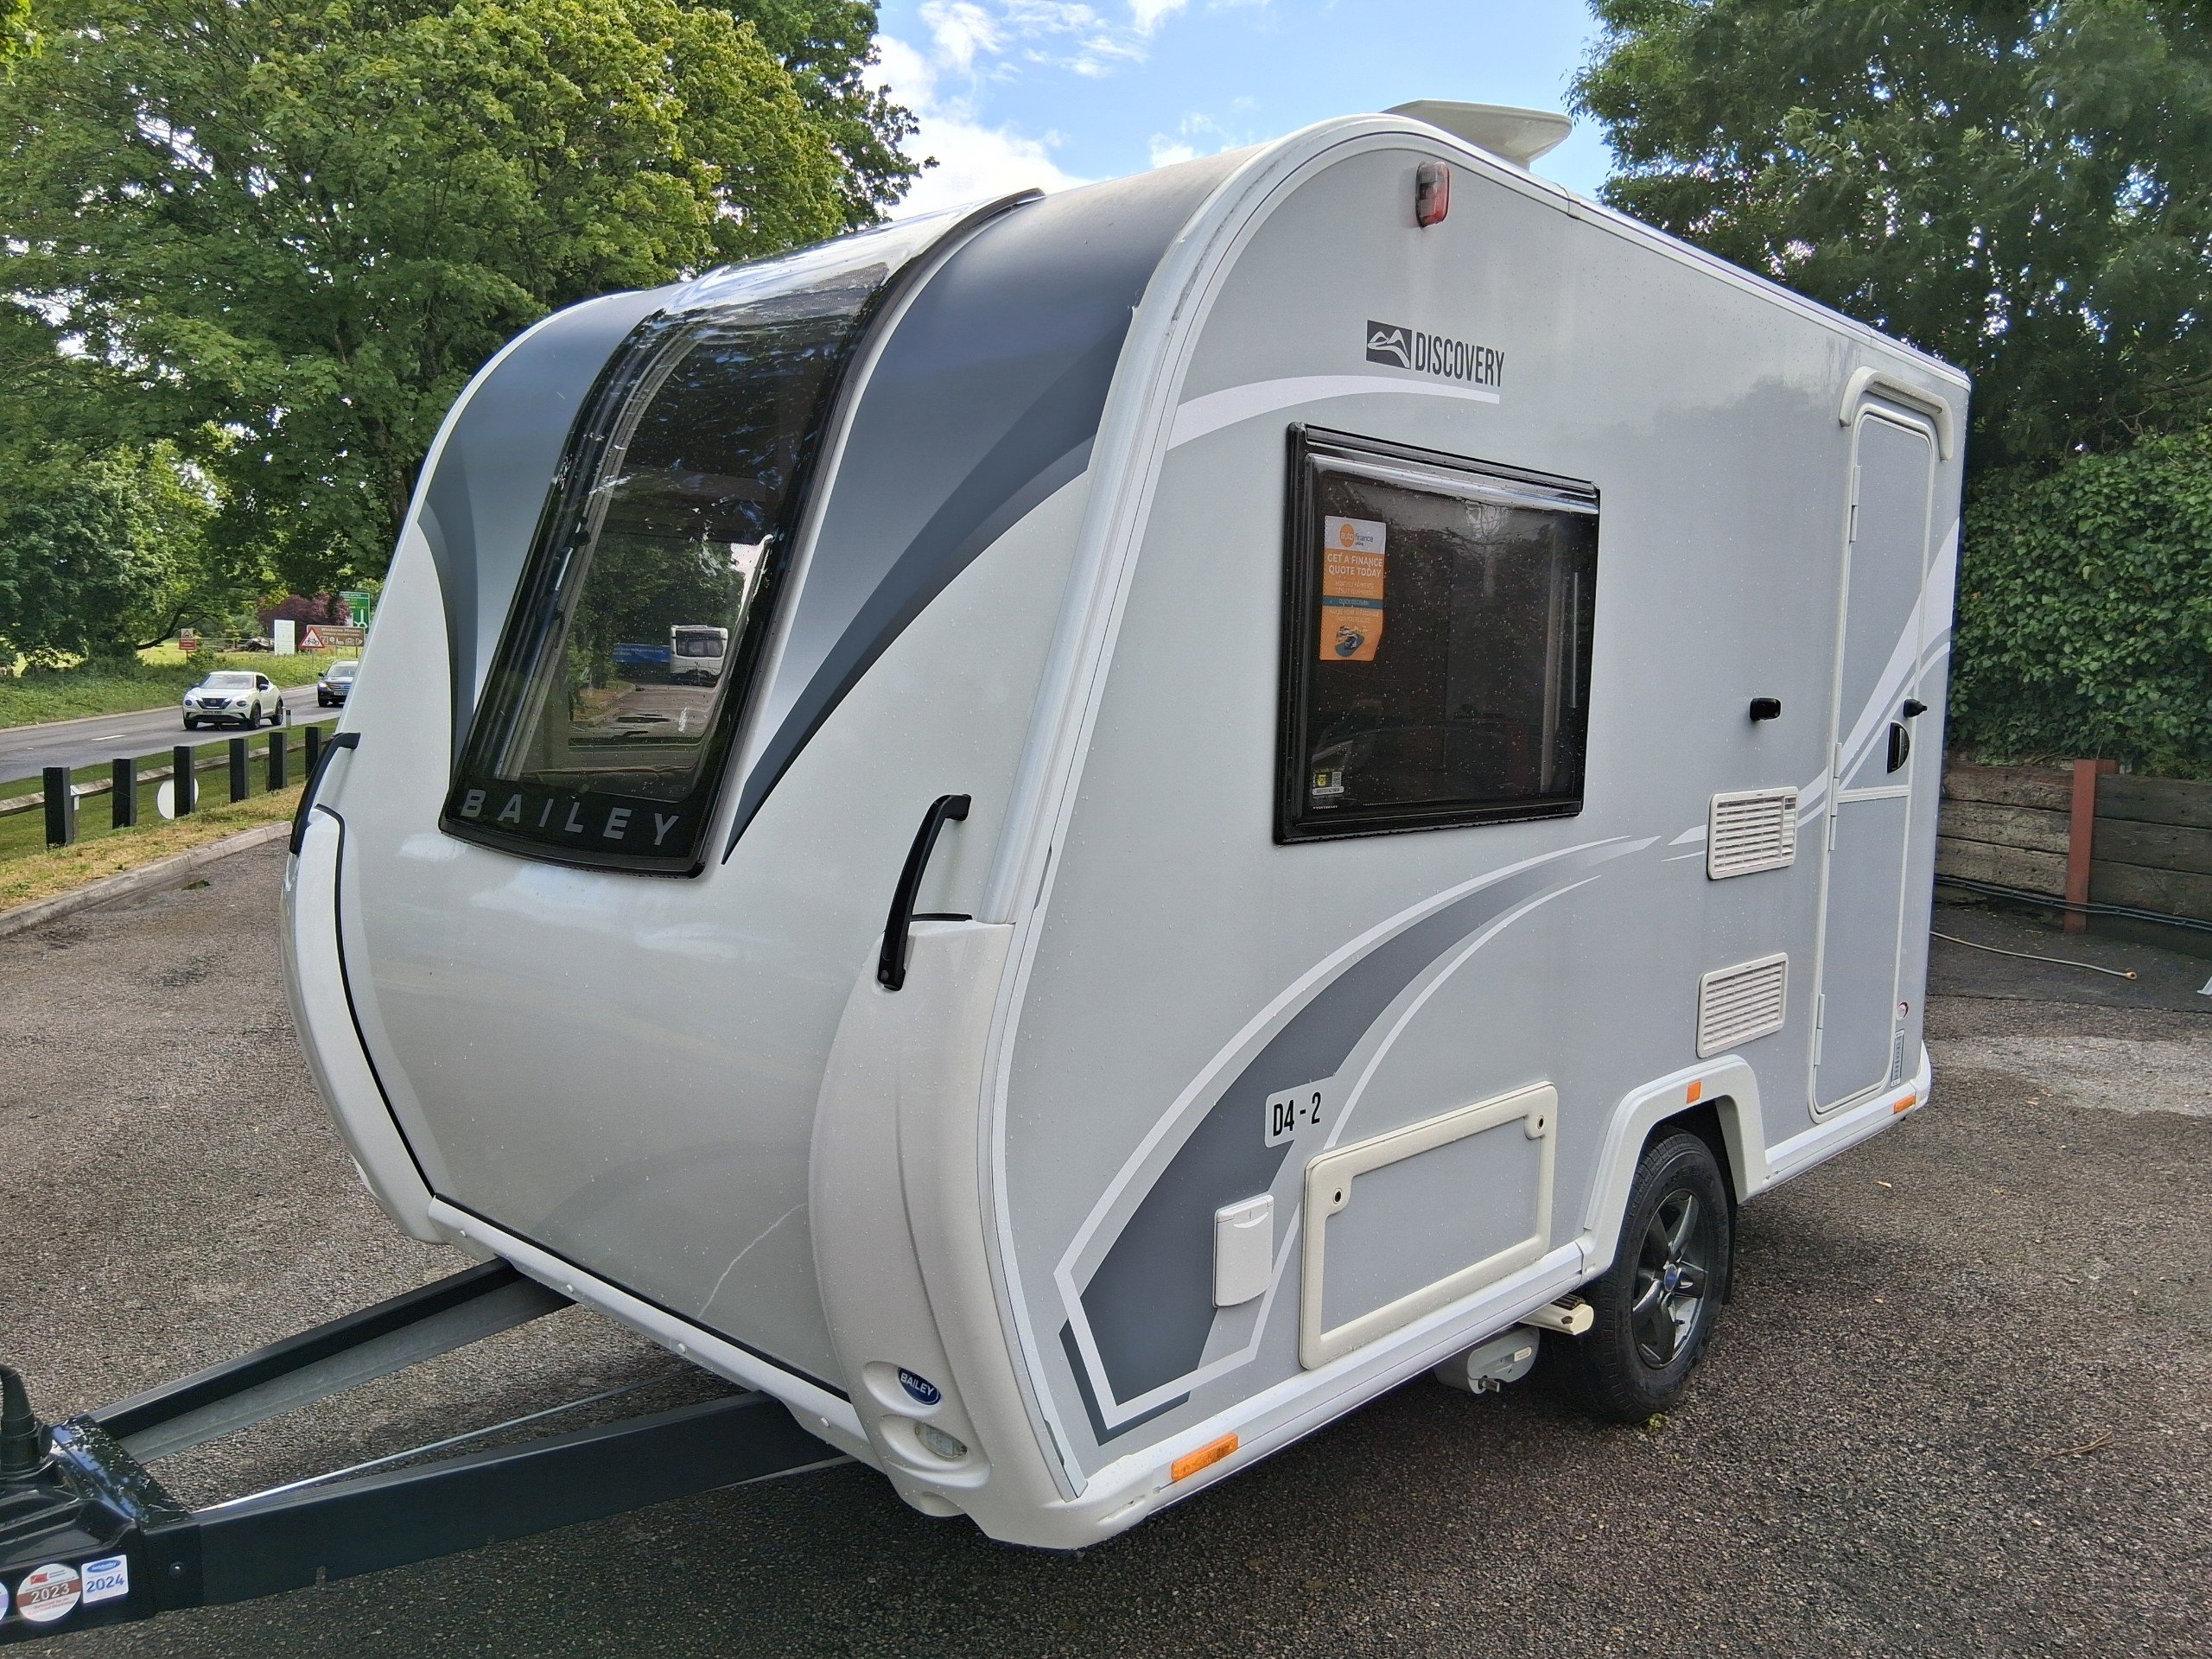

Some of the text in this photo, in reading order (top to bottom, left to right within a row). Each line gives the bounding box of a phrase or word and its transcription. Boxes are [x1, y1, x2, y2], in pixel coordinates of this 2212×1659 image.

[1415, 332, 1504, 387] DISCOVERY
[1340, 532, 1374, 543] auto finance
[1327, 554, 1383, 567] GET A FINANCE
[1329, 564, 1382, 578] QUOTE TODAY
[461, 789, 679, 846] BAILEY
[900, 1372, 934, 1395] BAILEY
[86, 1573, 124, 1592] 2024
[31, 1583, 70, 1604] 2023
